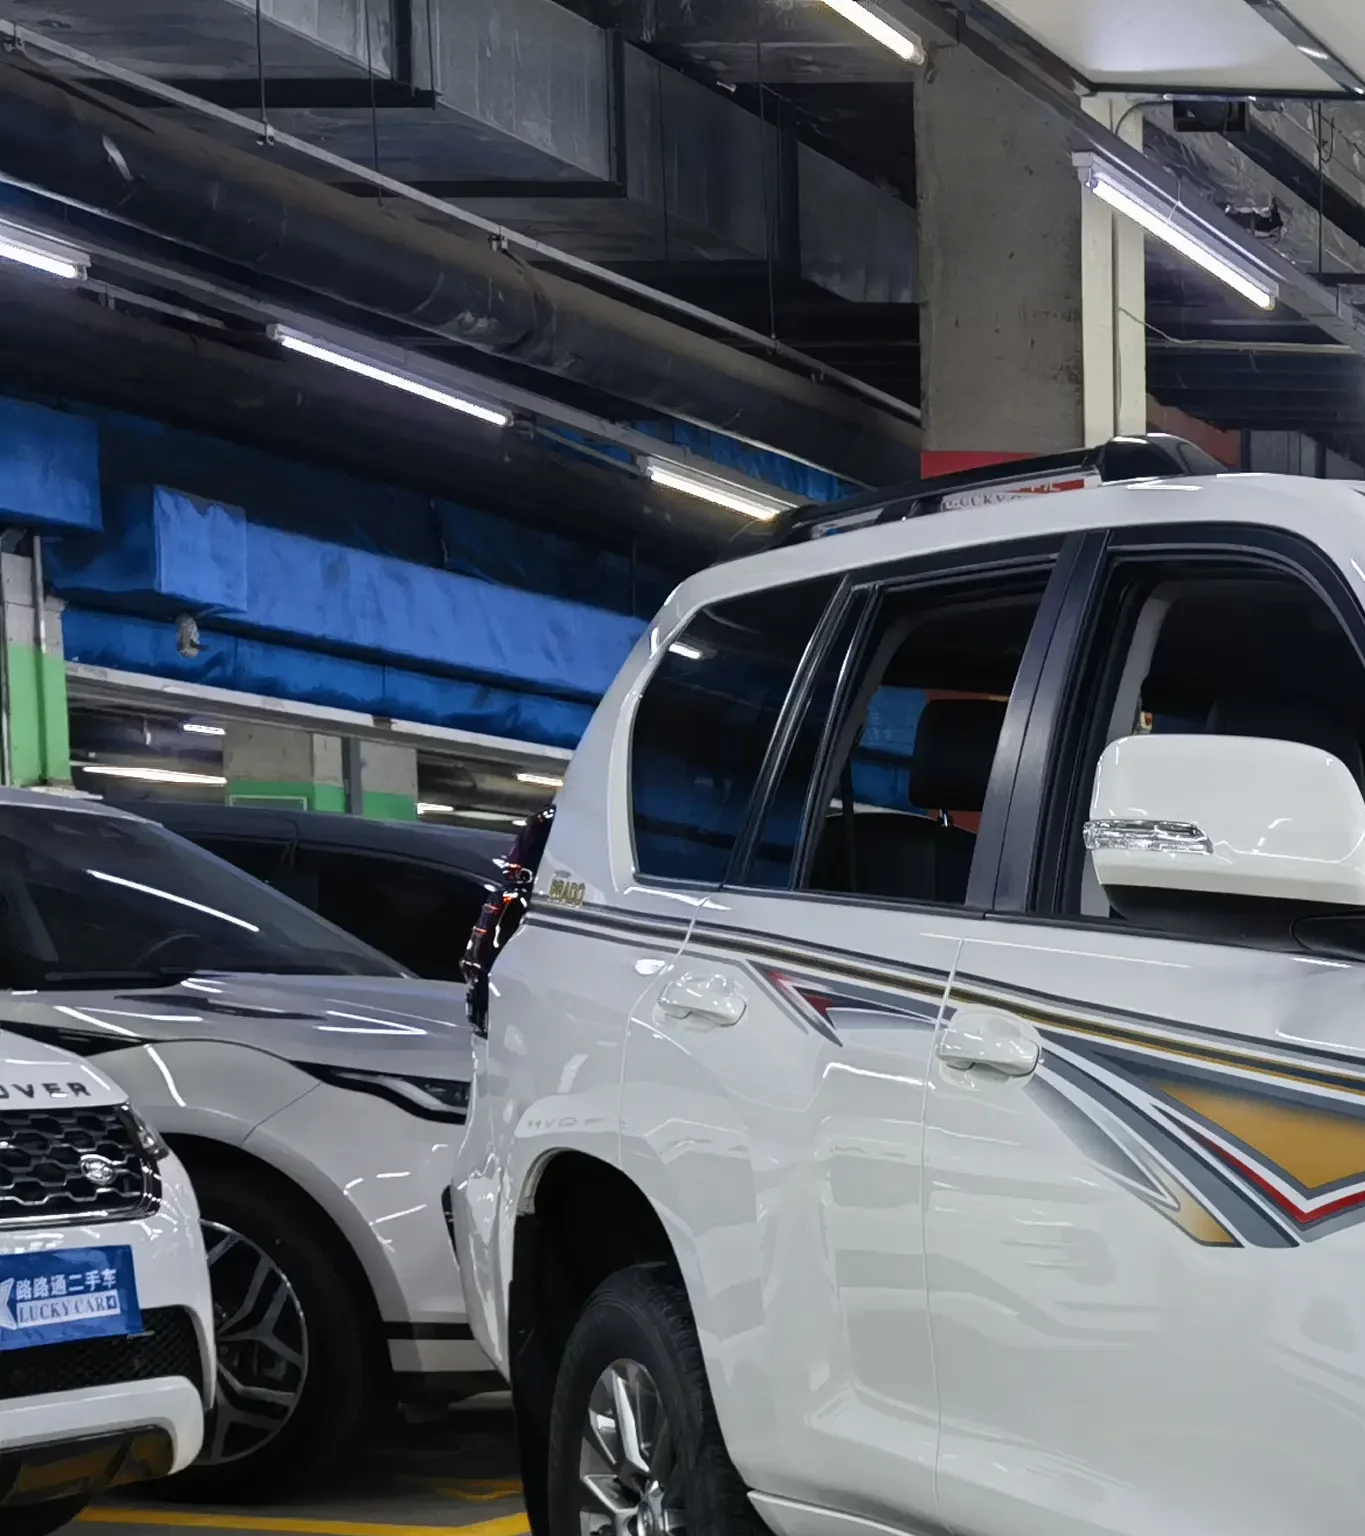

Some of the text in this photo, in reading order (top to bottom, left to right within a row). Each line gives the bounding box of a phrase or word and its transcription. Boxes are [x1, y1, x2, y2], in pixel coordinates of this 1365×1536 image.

[16, 1268, 117, 1301] 路路通二手车
[20, 1295, 106, 1323] LUCKY CAR
